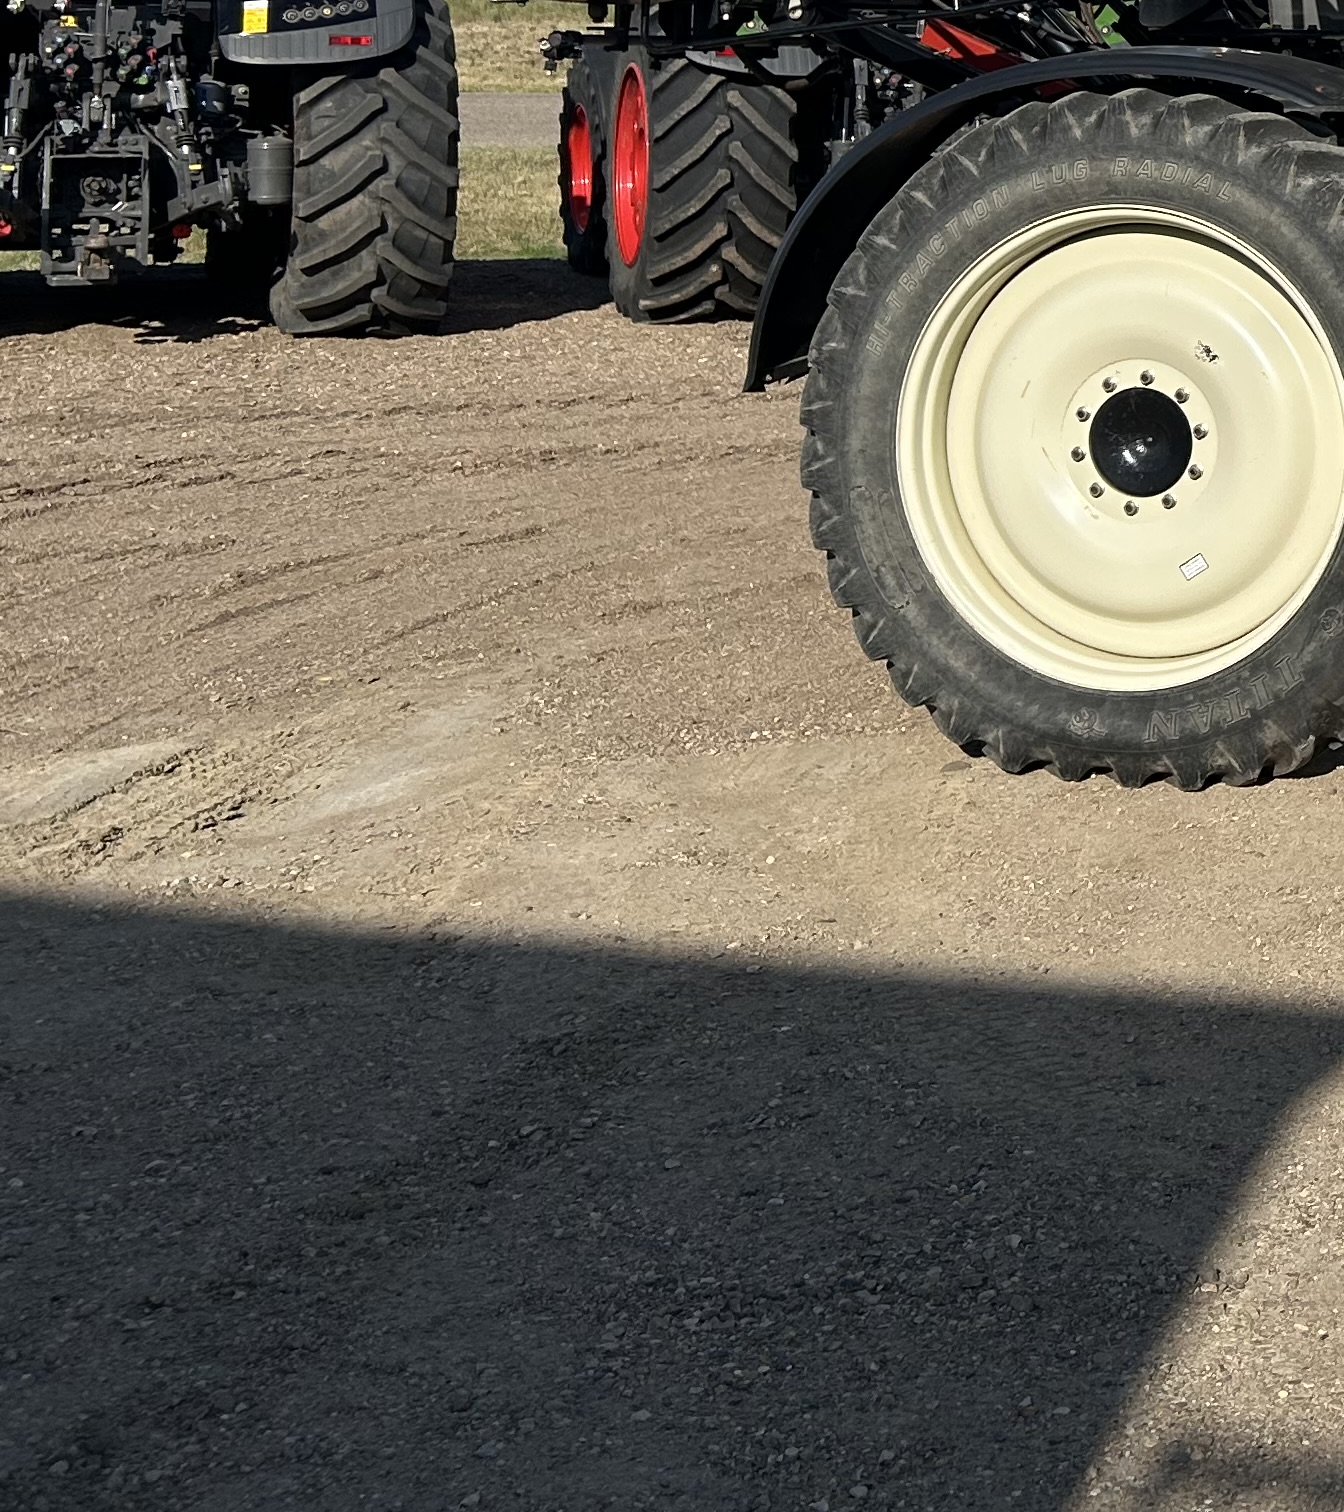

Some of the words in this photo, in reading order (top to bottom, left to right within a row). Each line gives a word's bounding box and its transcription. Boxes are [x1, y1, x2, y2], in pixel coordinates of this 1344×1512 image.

[865, 186, 1010, 358] HI-TRACTION
[1031, 159, 1089, 191] LUG
[1111, 156, 1233, 202] RADIAL
[1143, 652, 1305, 744] TITAN
